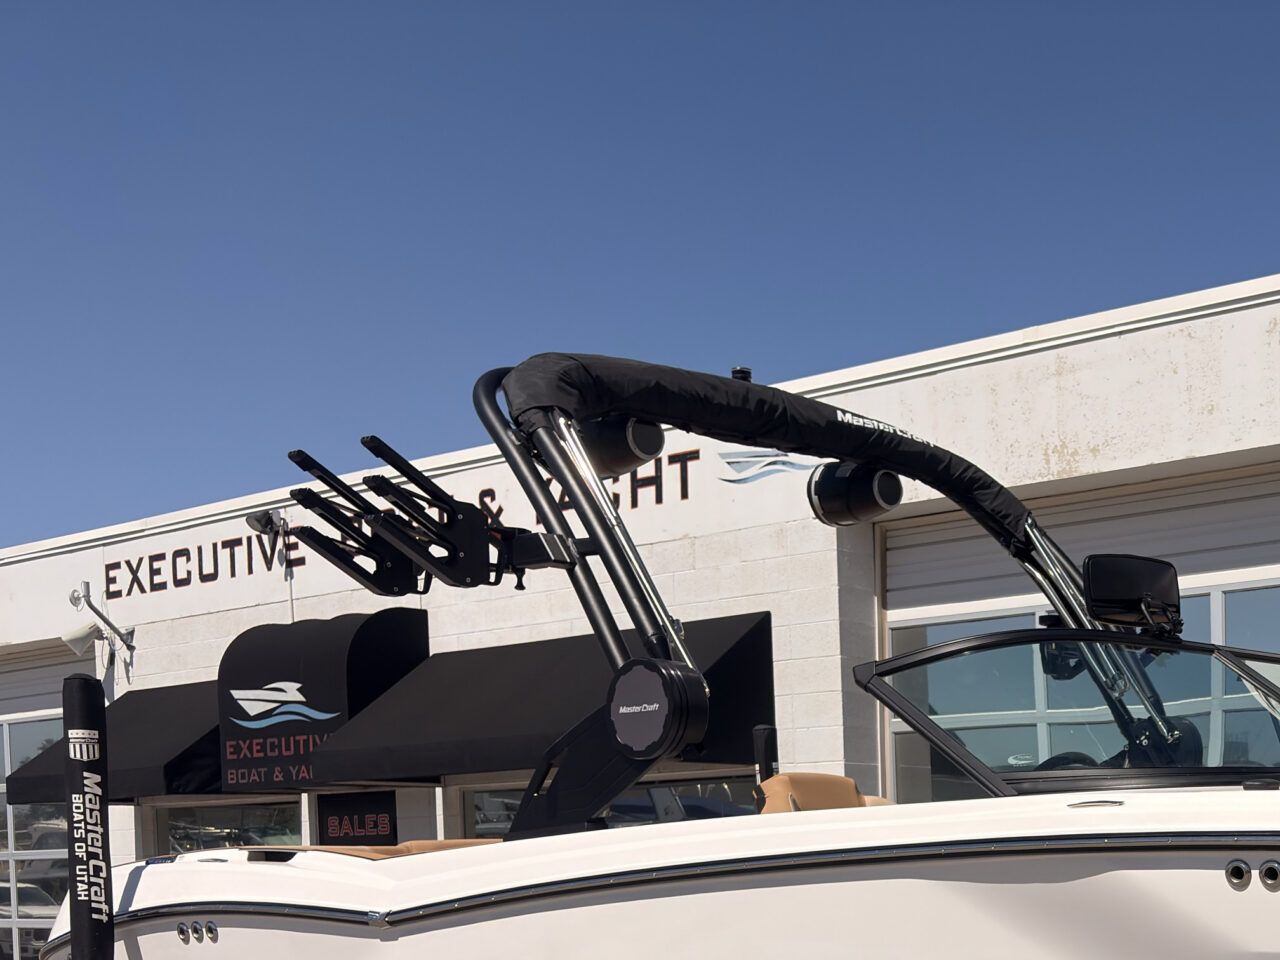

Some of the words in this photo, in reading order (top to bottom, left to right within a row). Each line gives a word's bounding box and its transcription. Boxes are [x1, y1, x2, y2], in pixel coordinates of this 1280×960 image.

[104, 526, 306, 600] EXECUTIVE
[226, 733, 331, 760] EXECUTIV
[227, 768, 269, 784] BOAT
[273, 766, 284, 782] &
[289, 764, 313, 781] YA
[71, 793, 86, 839] BOATS
[327, 813, 390, 837] SALES
[74, 842, 87, 861] OF
[83, 771, 108, 924] MasterCraft
[76, 865, 89, 900] UTAH
